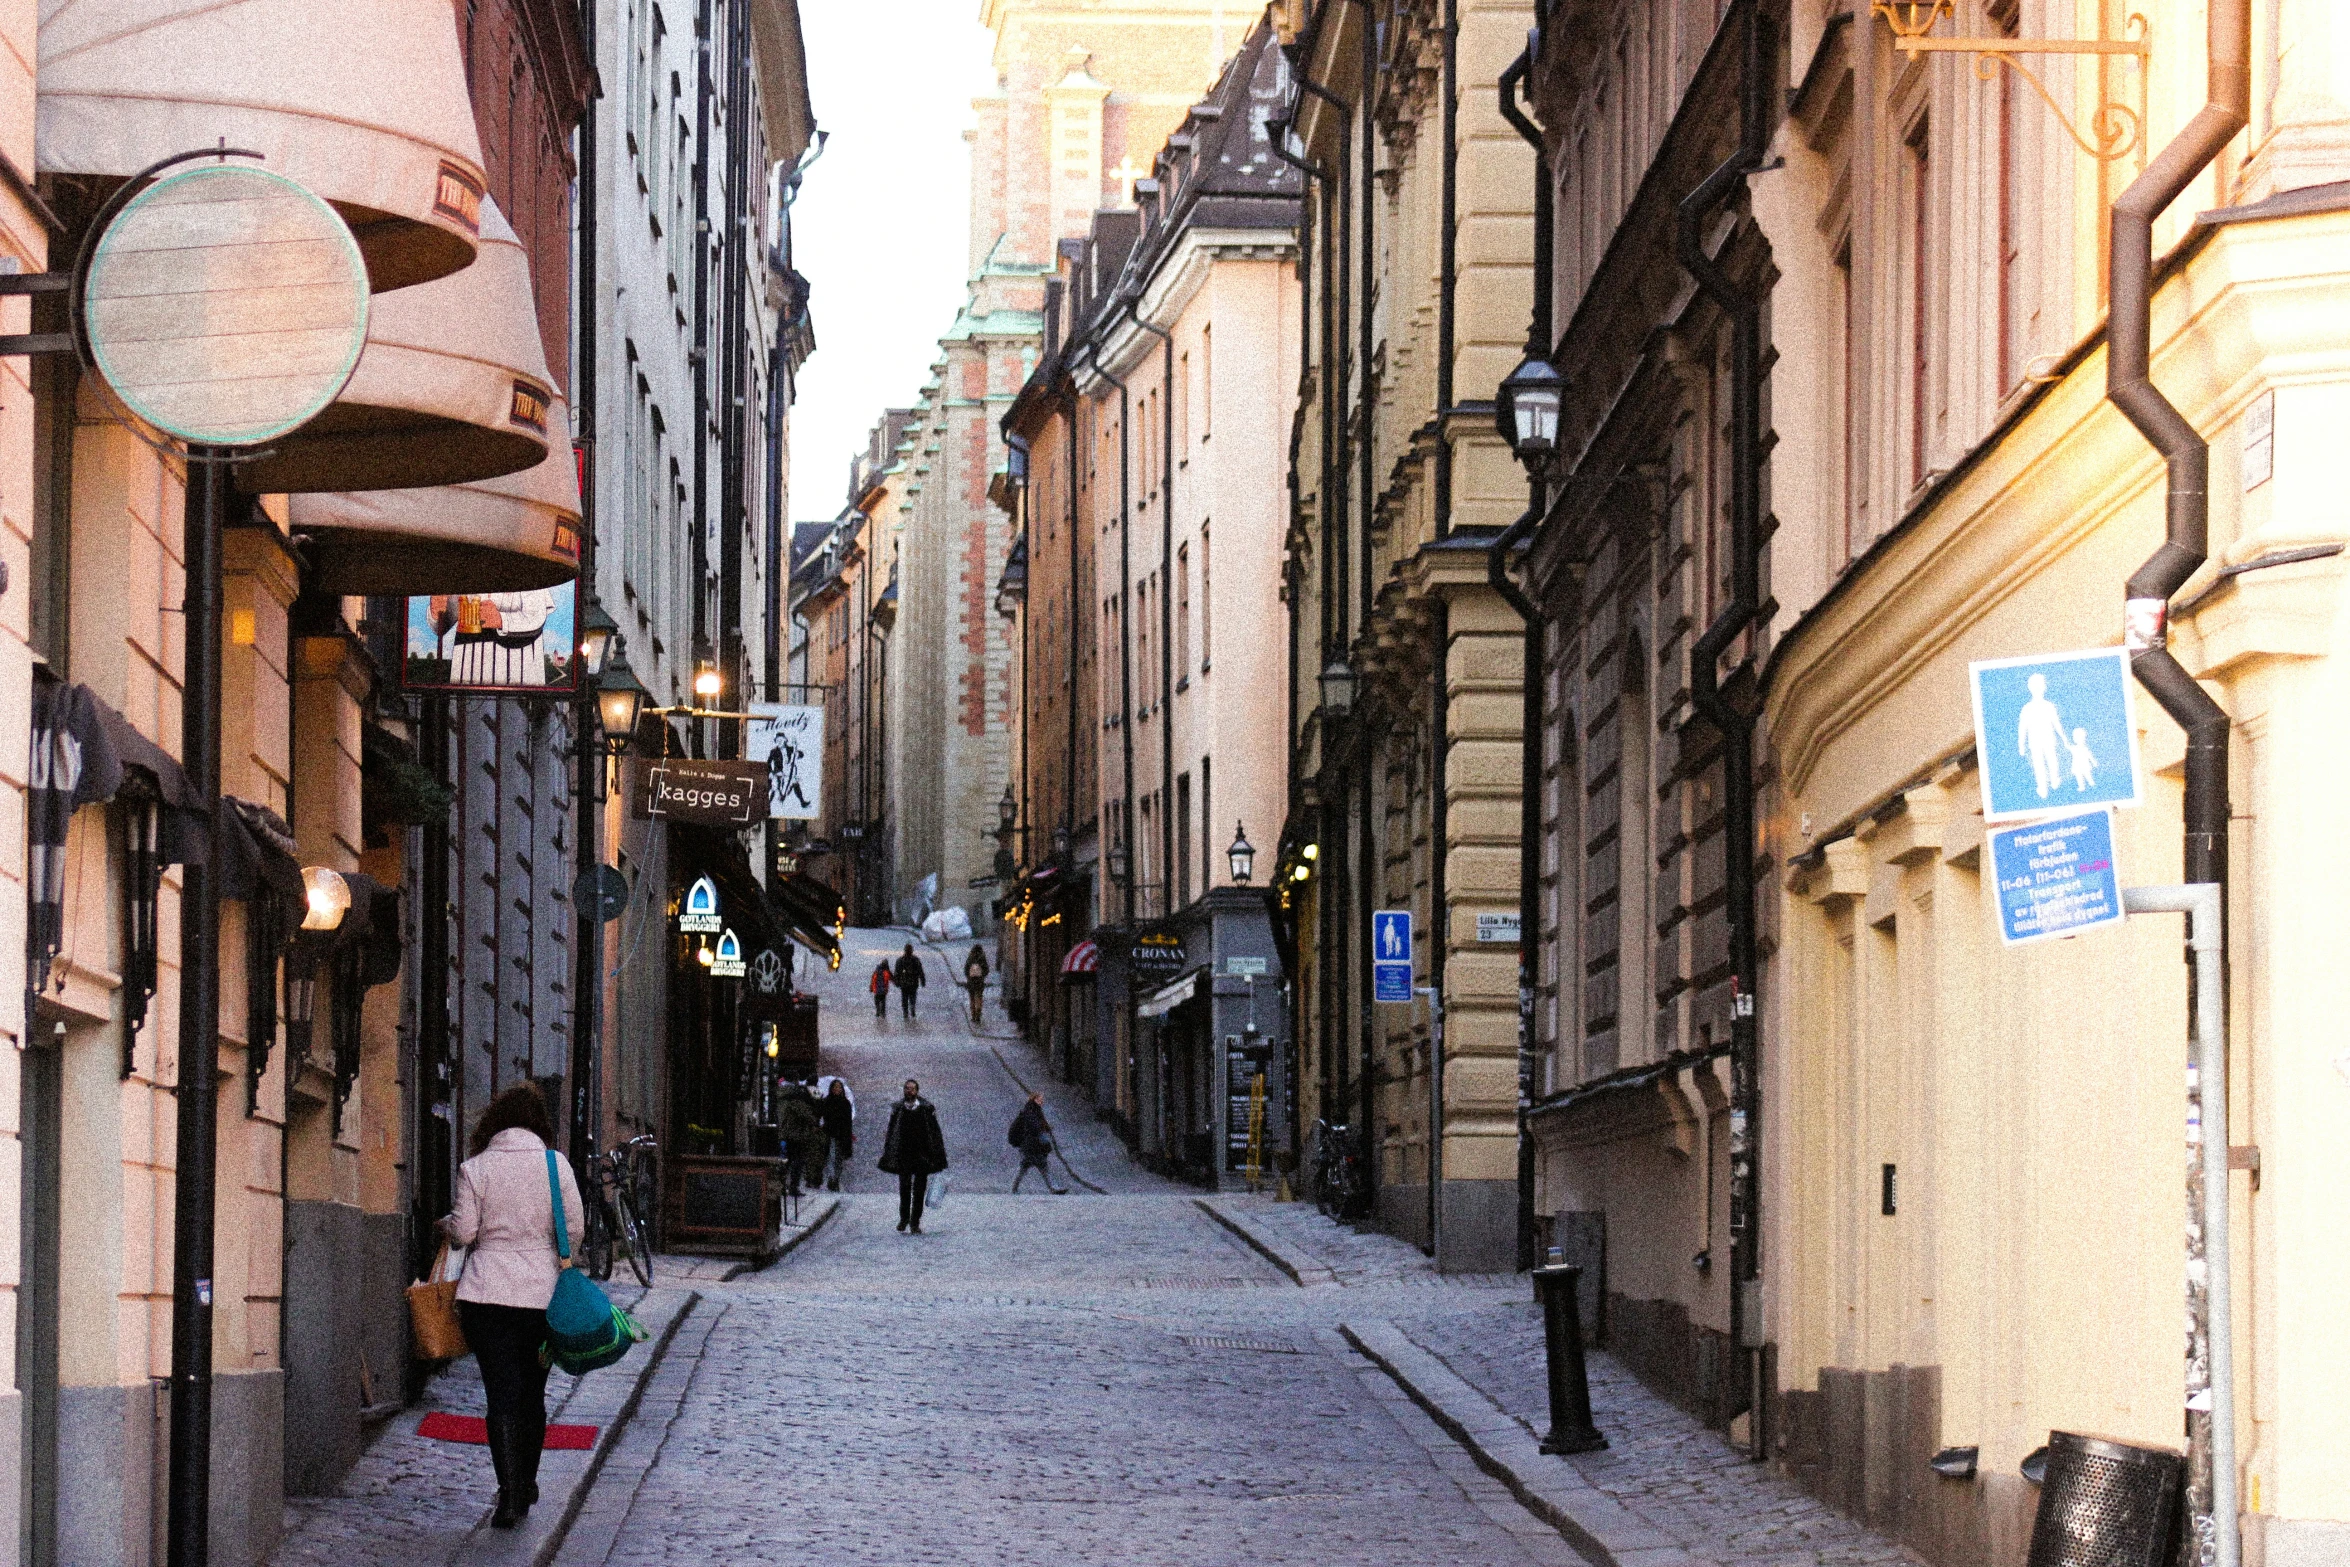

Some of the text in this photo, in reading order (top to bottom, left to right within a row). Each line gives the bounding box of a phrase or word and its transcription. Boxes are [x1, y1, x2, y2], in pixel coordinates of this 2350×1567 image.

[755, 712, 810, 732] Movitz
[659, 781, 740, 808] kagges
[2038, 840, 2067, 855] trafik
[2029, 852, 2079, 870] förbjuden
[2001, 876, 2031, 891] 11-06
[2035, 865, 2076, 884] (11-06)
[2028, 880, 2082, 899] Transport
[679, 914, 722, 924] GOTLANDS
[680, 923, 721, 932] BRYGGERI
[1480, 929, 1491, 939] 23
[1132, 947, 1185, 960] CRONAN
